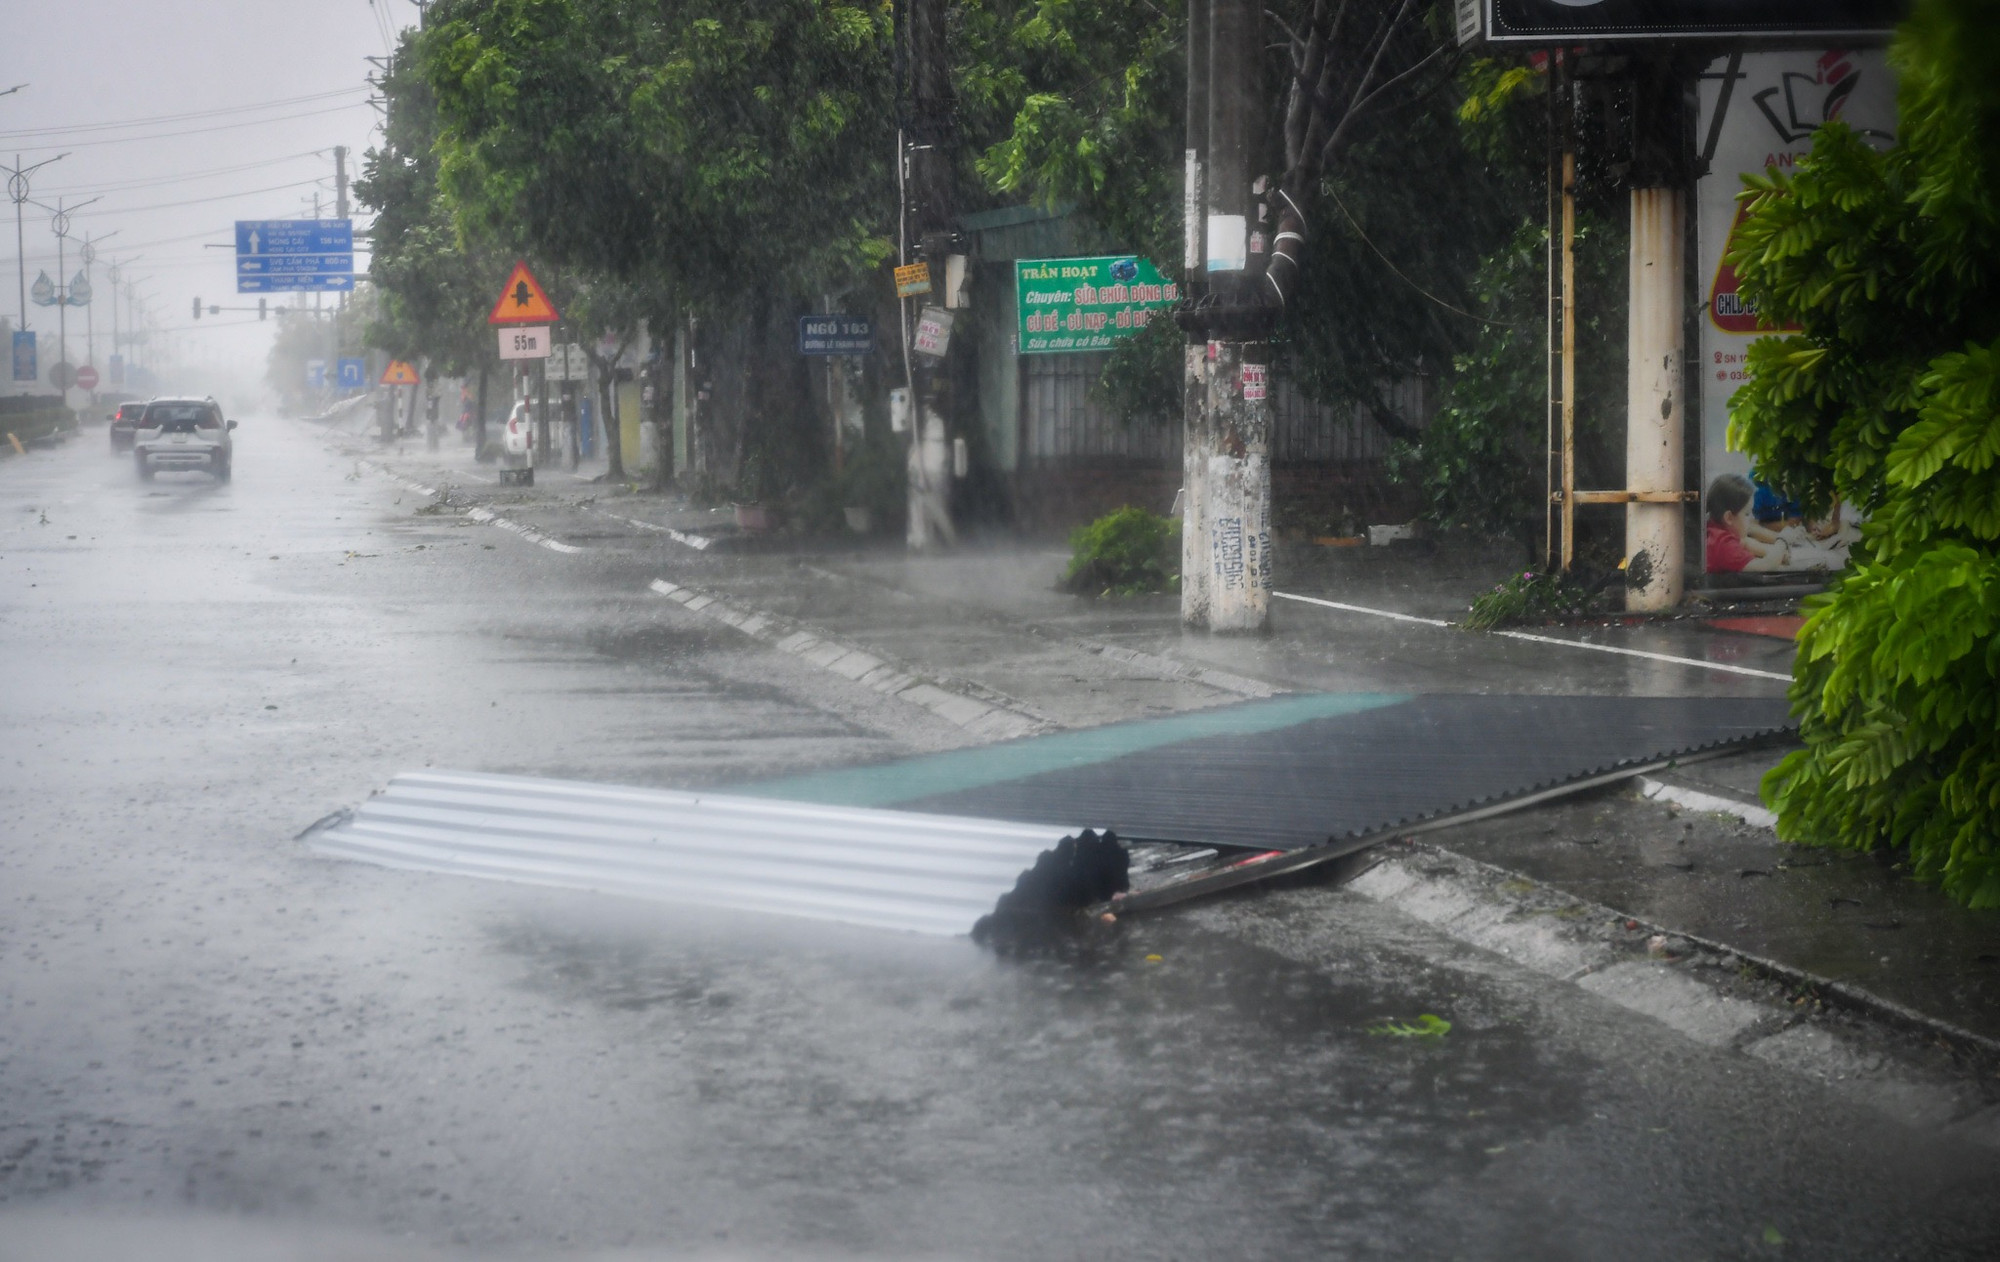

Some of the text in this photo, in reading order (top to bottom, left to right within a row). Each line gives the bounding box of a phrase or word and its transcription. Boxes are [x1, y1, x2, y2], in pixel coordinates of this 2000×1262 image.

[1061, 266, 1098, 280] HOẠT
[1026, 291, 1072, 305] Chuyên:
[1074, 282, 1098, 305] SỬA
[1098, 282, 1130, 304] CHỮA
[1130, 282, 1162, 307] ĐỘNG
[1026, 309, 1043, 332] CỦ
[1044, 309, 1059, 332] ĐỀ
[1067, 308, 1083, 331] CỦ
[1084, 312, 1108, 334] NẠP
[1115, 305, 1132, 329] ĐỒ
[513, 334, 537, 351] 55m
[1027, 338, 1047, 350] Sửa
[1049, 337, 1073, 349] chữa
[1076, 336, 1089, 347] có
[1091, 334, 1111, 347] Bảo
